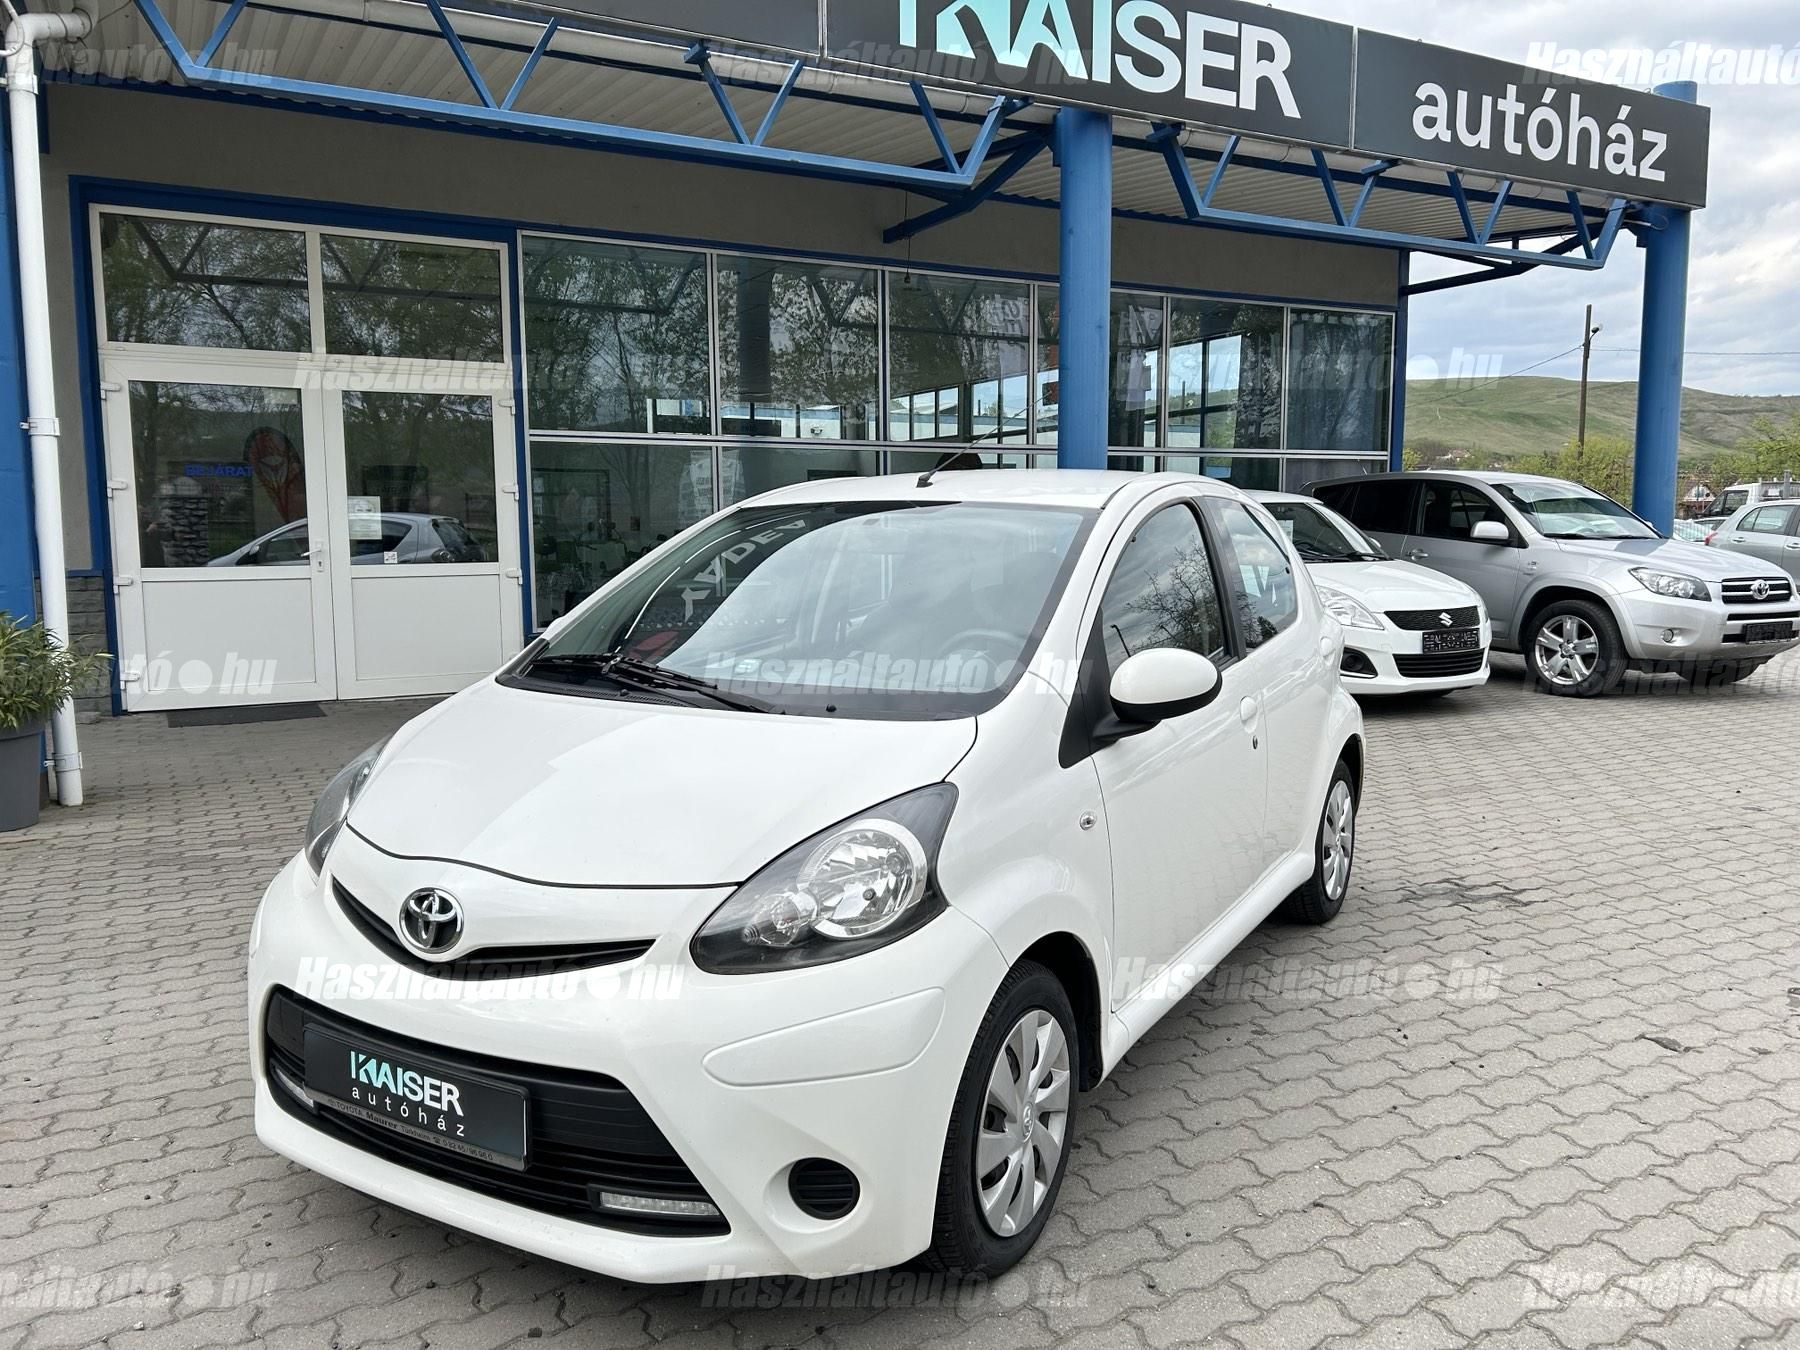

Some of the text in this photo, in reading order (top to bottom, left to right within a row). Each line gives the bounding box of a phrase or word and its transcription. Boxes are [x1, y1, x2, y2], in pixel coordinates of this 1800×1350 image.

[900, 0, 1302, 119] KAISER
[1412, 82, 1668, 182] autóház
[351, 1051, 464, 1116] KAISER
[351, 1086, 465, 1137] autóház
[366, 1111, 398, 1130] Maurer
